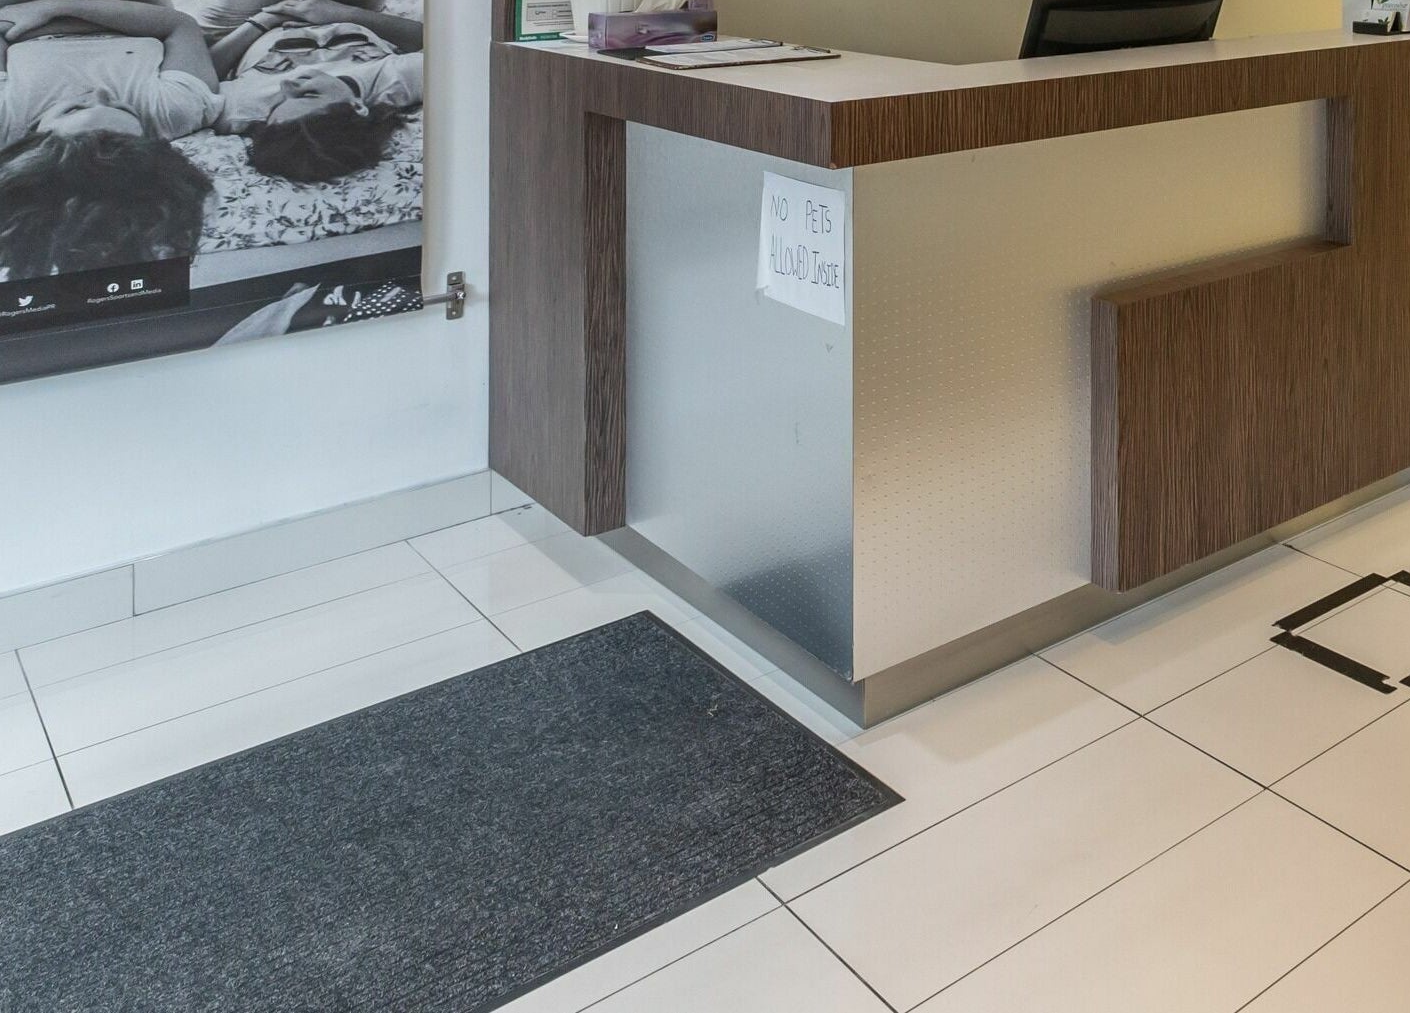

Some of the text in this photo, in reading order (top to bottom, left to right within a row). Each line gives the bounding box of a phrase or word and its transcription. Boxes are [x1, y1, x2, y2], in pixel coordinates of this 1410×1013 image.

[770, 195, 832, 234] NO PETS
[769, 233, 810, 282] ALLOWED
